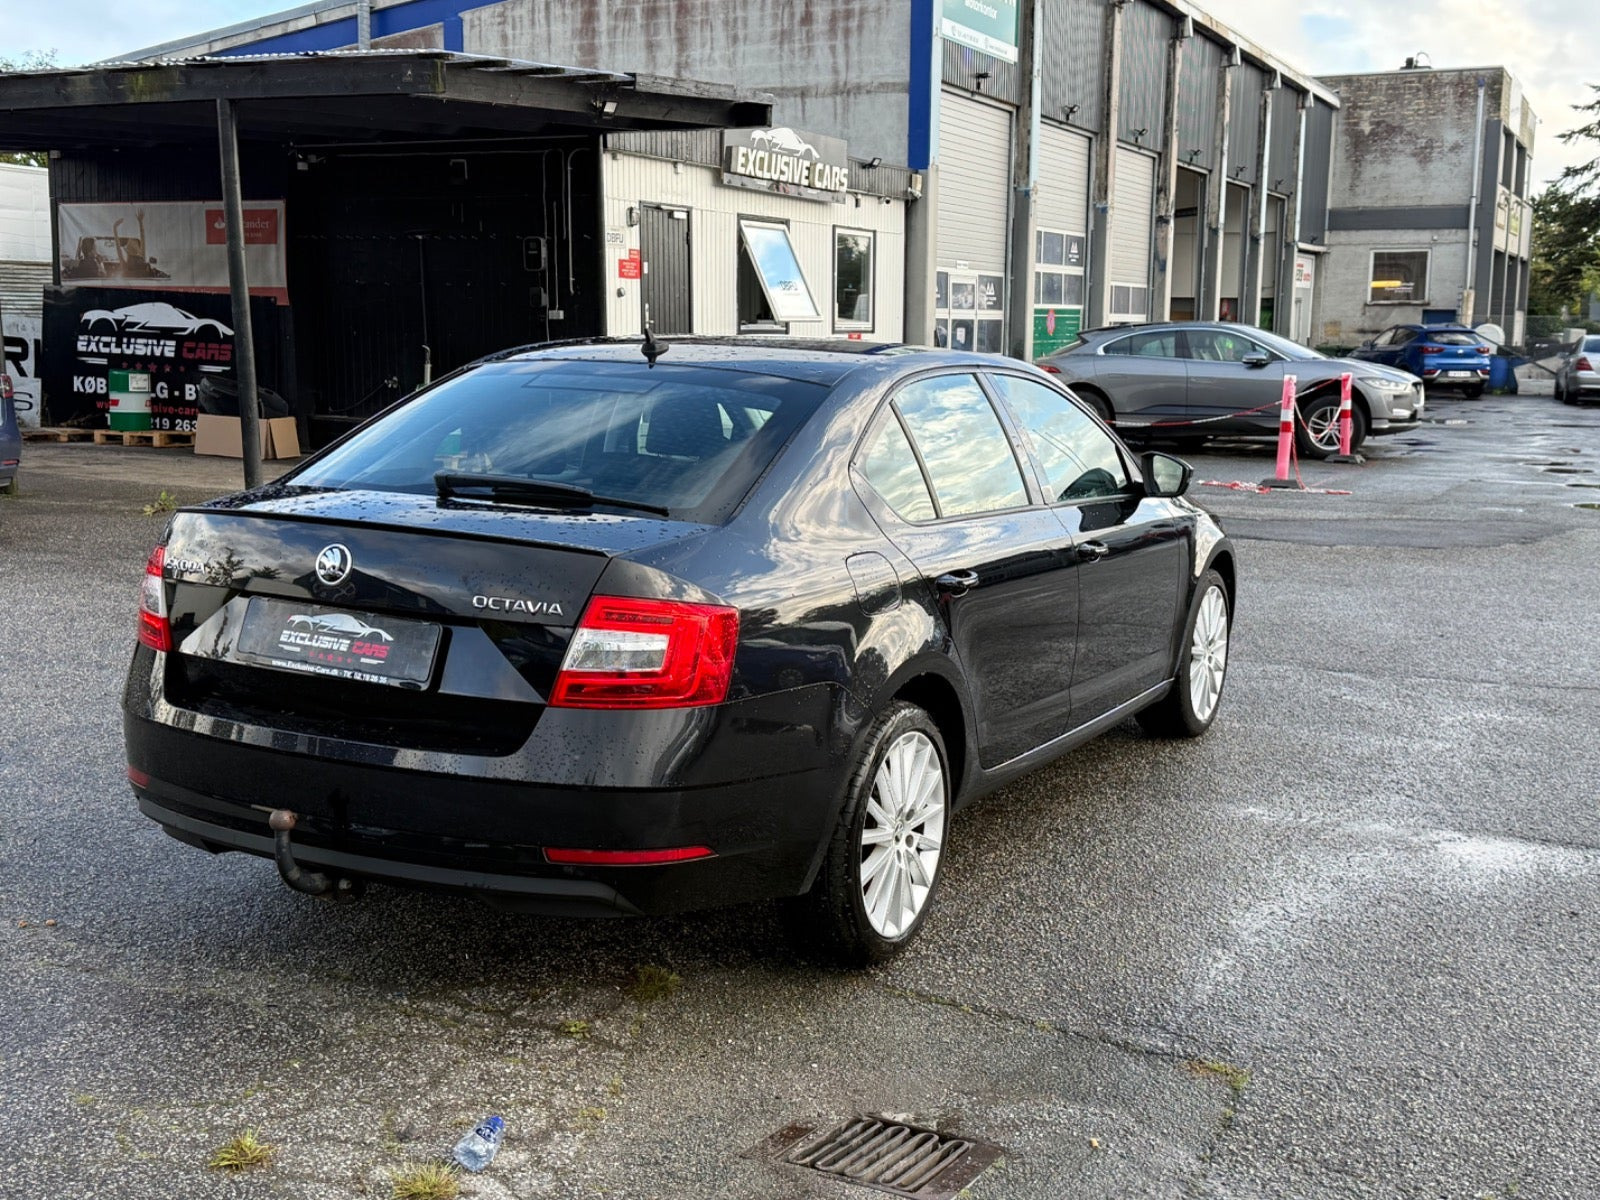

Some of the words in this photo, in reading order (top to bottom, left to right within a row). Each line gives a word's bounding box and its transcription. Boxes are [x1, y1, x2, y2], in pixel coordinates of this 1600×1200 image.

[736, 145, 811, 187] EXCLUSIVE
[814, 161, 849, 193] CARS
[76, 335, 177, 358] EXCLUSIVE
[182, 341, 233, 362] CARS
[73, 375, 107, 394] KØB
[472, 595, 564, 616] OCTAVIA
[279, 629, 351, 652] EXCLUSIVE
[351, 640, 390, 659] CARS
